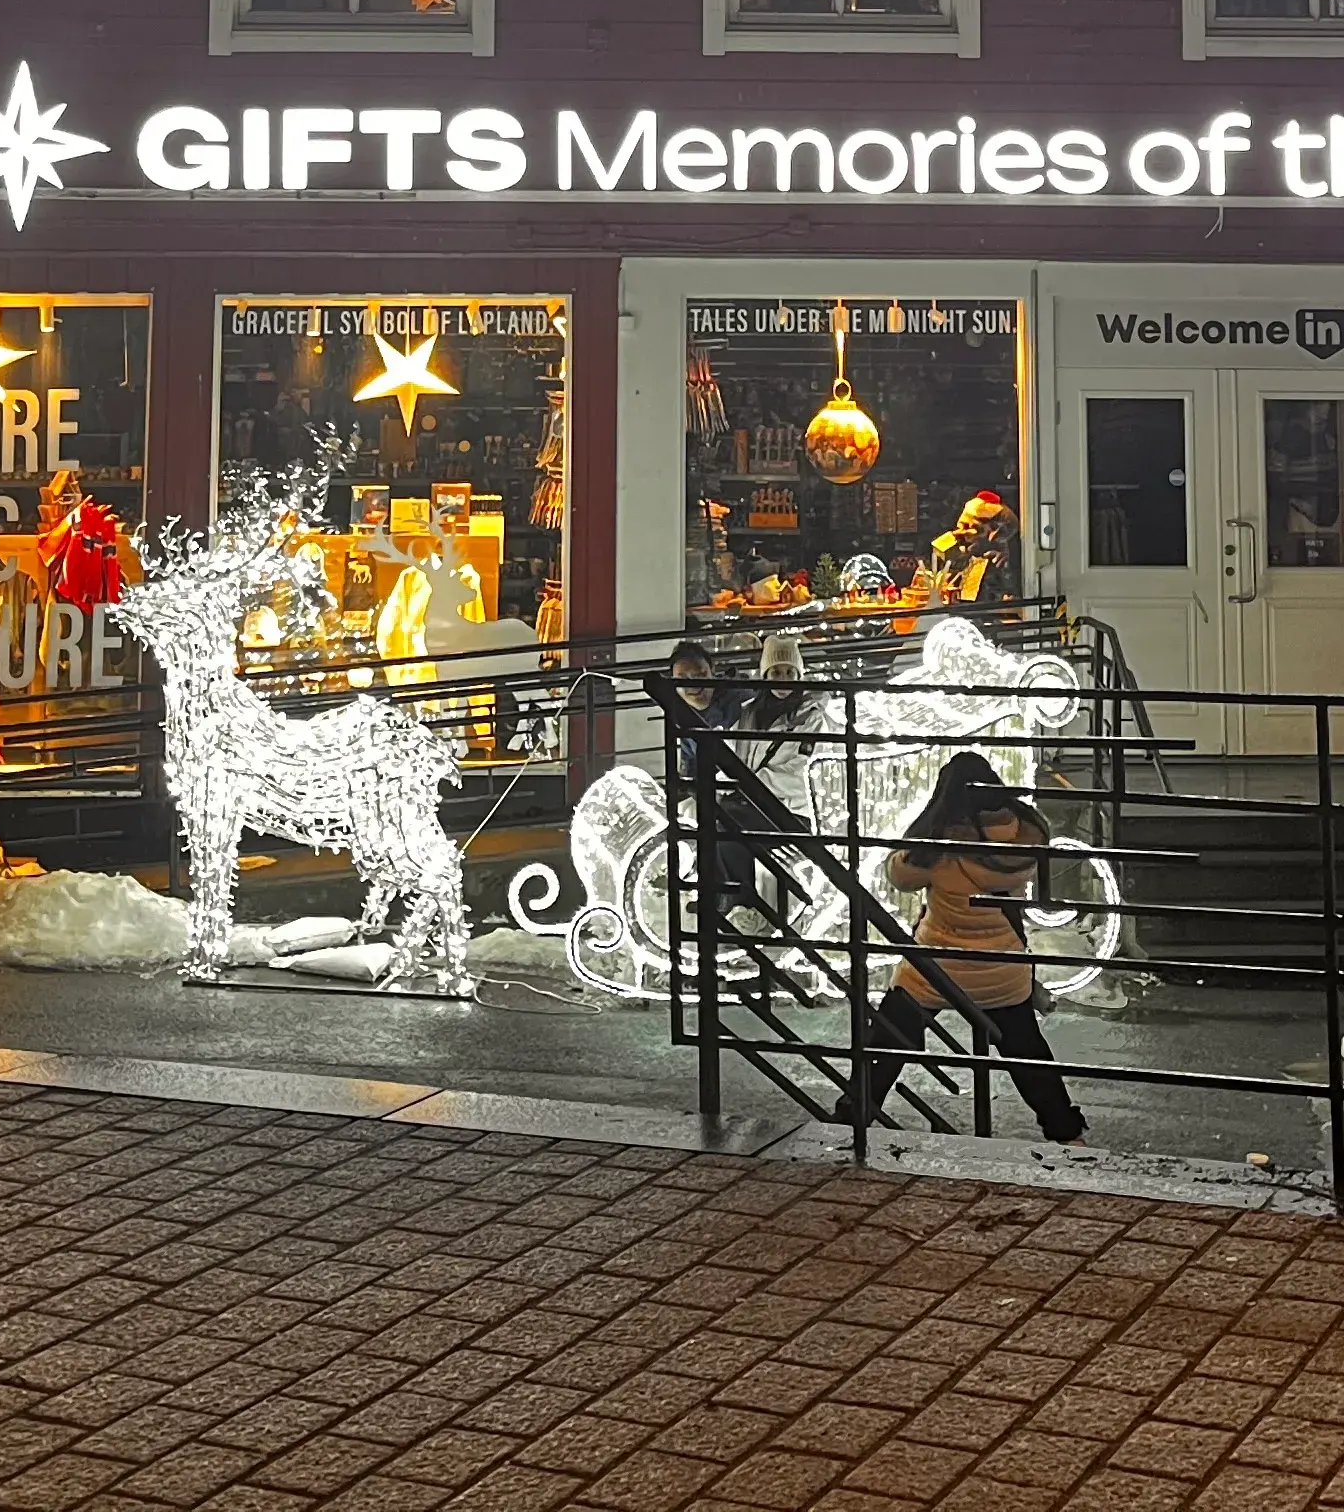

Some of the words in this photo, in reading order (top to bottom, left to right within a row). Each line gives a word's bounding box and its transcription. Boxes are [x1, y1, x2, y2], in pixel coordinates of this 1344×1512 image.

[136, 106, 527, 193] GIFTS
[557, 110, 1109, 195] Memories
[1128, 112, 1252, 197] of
[231, 309, 334, 336] GRACEFL
[689, 307, 749, 333] TALES
[754, 307, 821, 333] UNDER
[825, 308, 863, 334] TE
[971, 308, 1018, 335] SUN.
[1095, 312, 1290, 345] Welcome
